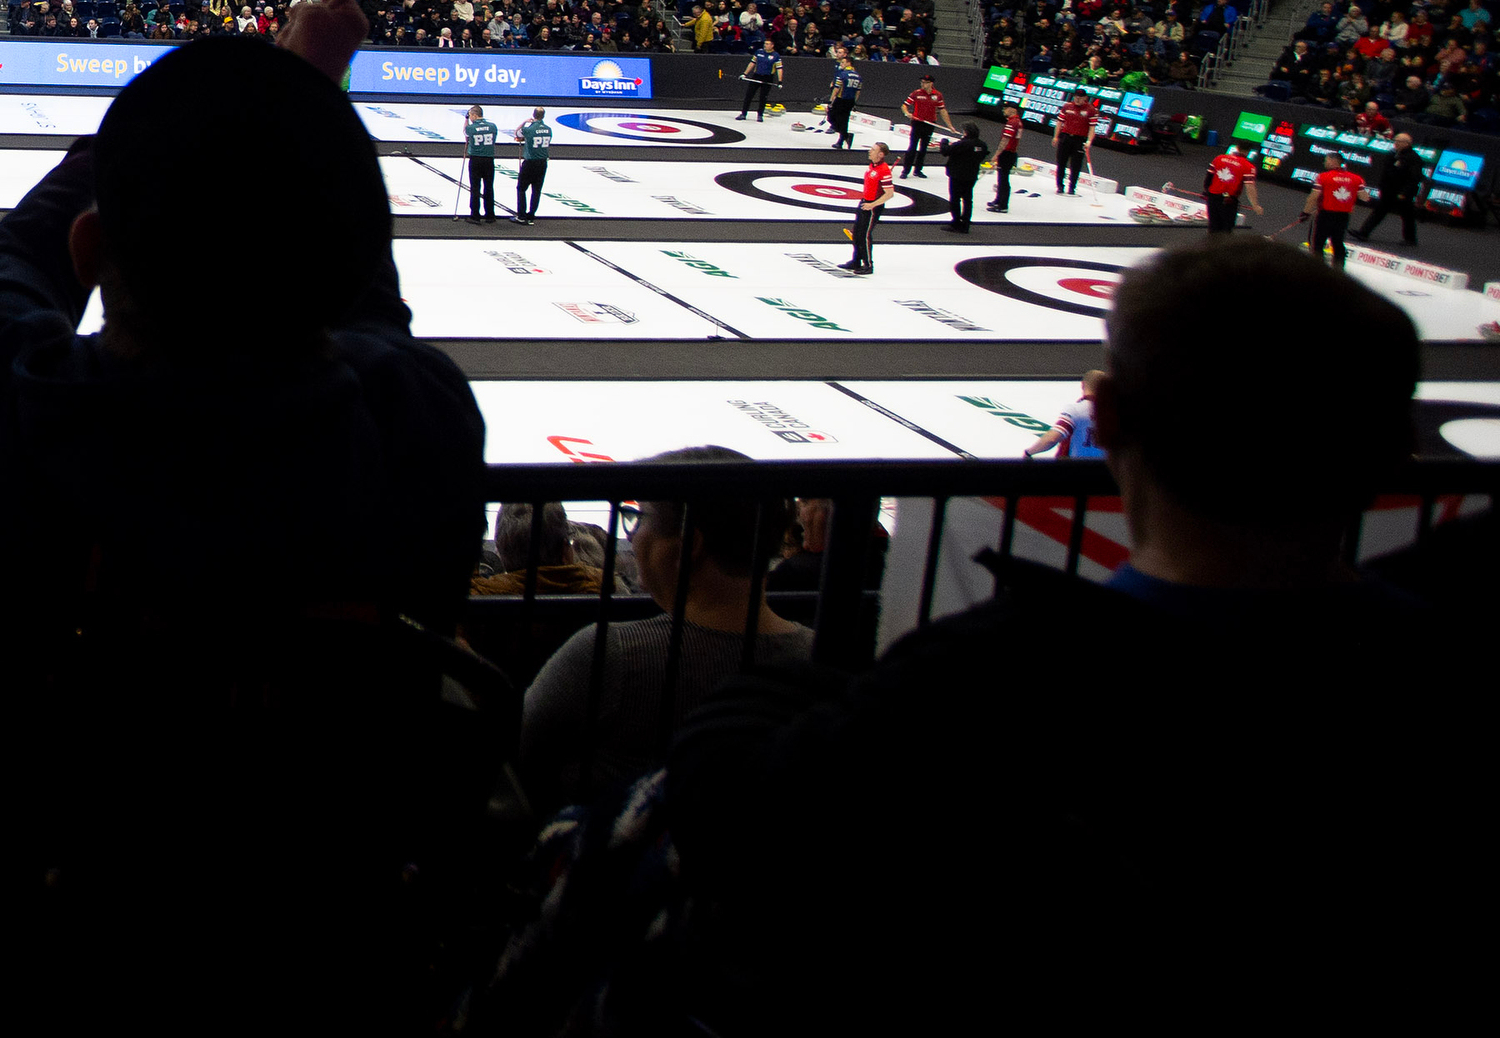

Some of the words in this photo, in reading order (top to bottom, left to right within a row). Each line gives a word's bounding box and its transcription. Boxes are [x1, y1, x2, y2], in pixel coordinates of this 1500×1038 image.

[56, 53, 128, 77] Sweep
[382, 62, 450, 86] Sweep
[455, 64, 480, 88] by
[484, 64, 526, 89] day.
[582, 79, 613, 91] Days
[614, 79, 636, 90] Inn
[679, 256, 740, 279] AGI
[1357, 252, 1400, 271] POINTSBET
[1404, 265, 1449, 284] POINTSBET
[779, 307, 853, 332] AGI
[727, 399, 789, 429] CURLING
[752, 401, 810, 429] CANADA
